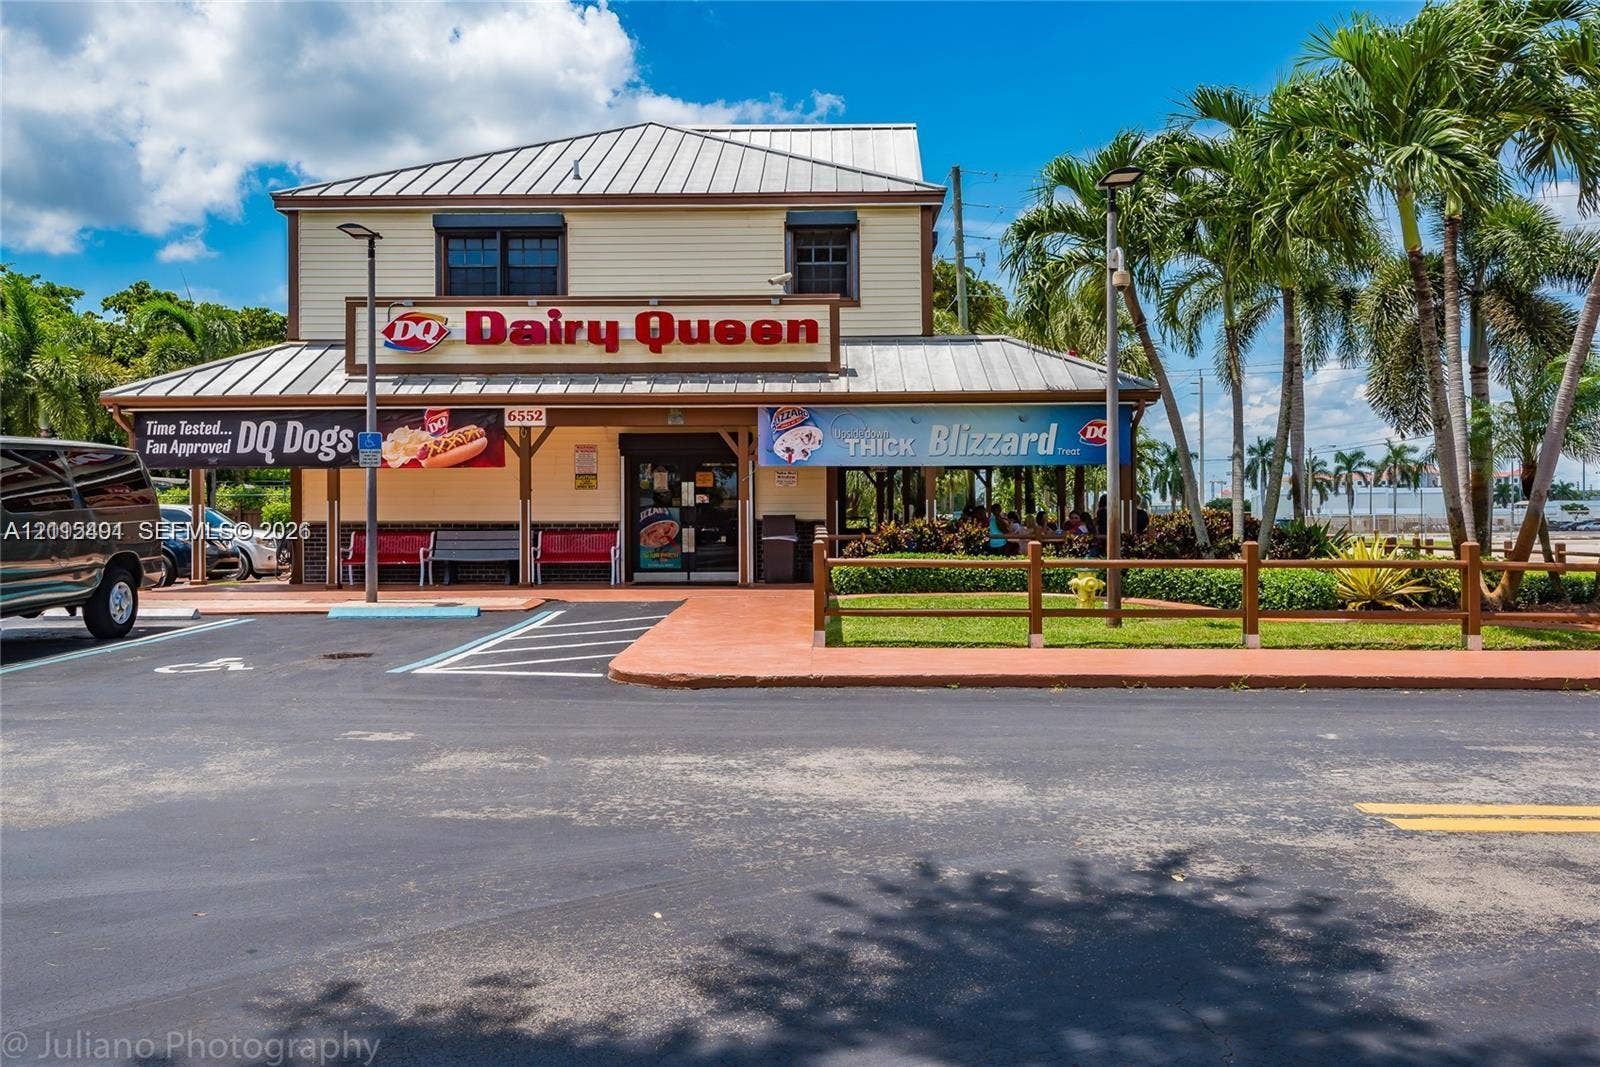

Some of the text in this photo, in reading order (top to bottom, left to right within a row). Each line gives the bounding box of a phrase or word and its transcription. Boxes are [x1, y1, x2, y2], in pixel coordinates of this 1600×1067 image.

[391, 320, 437, 344] DQ
[465, 308, 819, 354] Dairy Queen
[507, 409, 544, 422] 6552
[145, 420, 233, 436] Time Tested...
[145, 439, 231, 457] Fan Approved
[236, 420, 354, 464] DQ Dogs
[845, 438, 916, 457] THICK
[928, 422, 1058, 457] Blizzard
[1057, 447, 1081, 456] Treat
